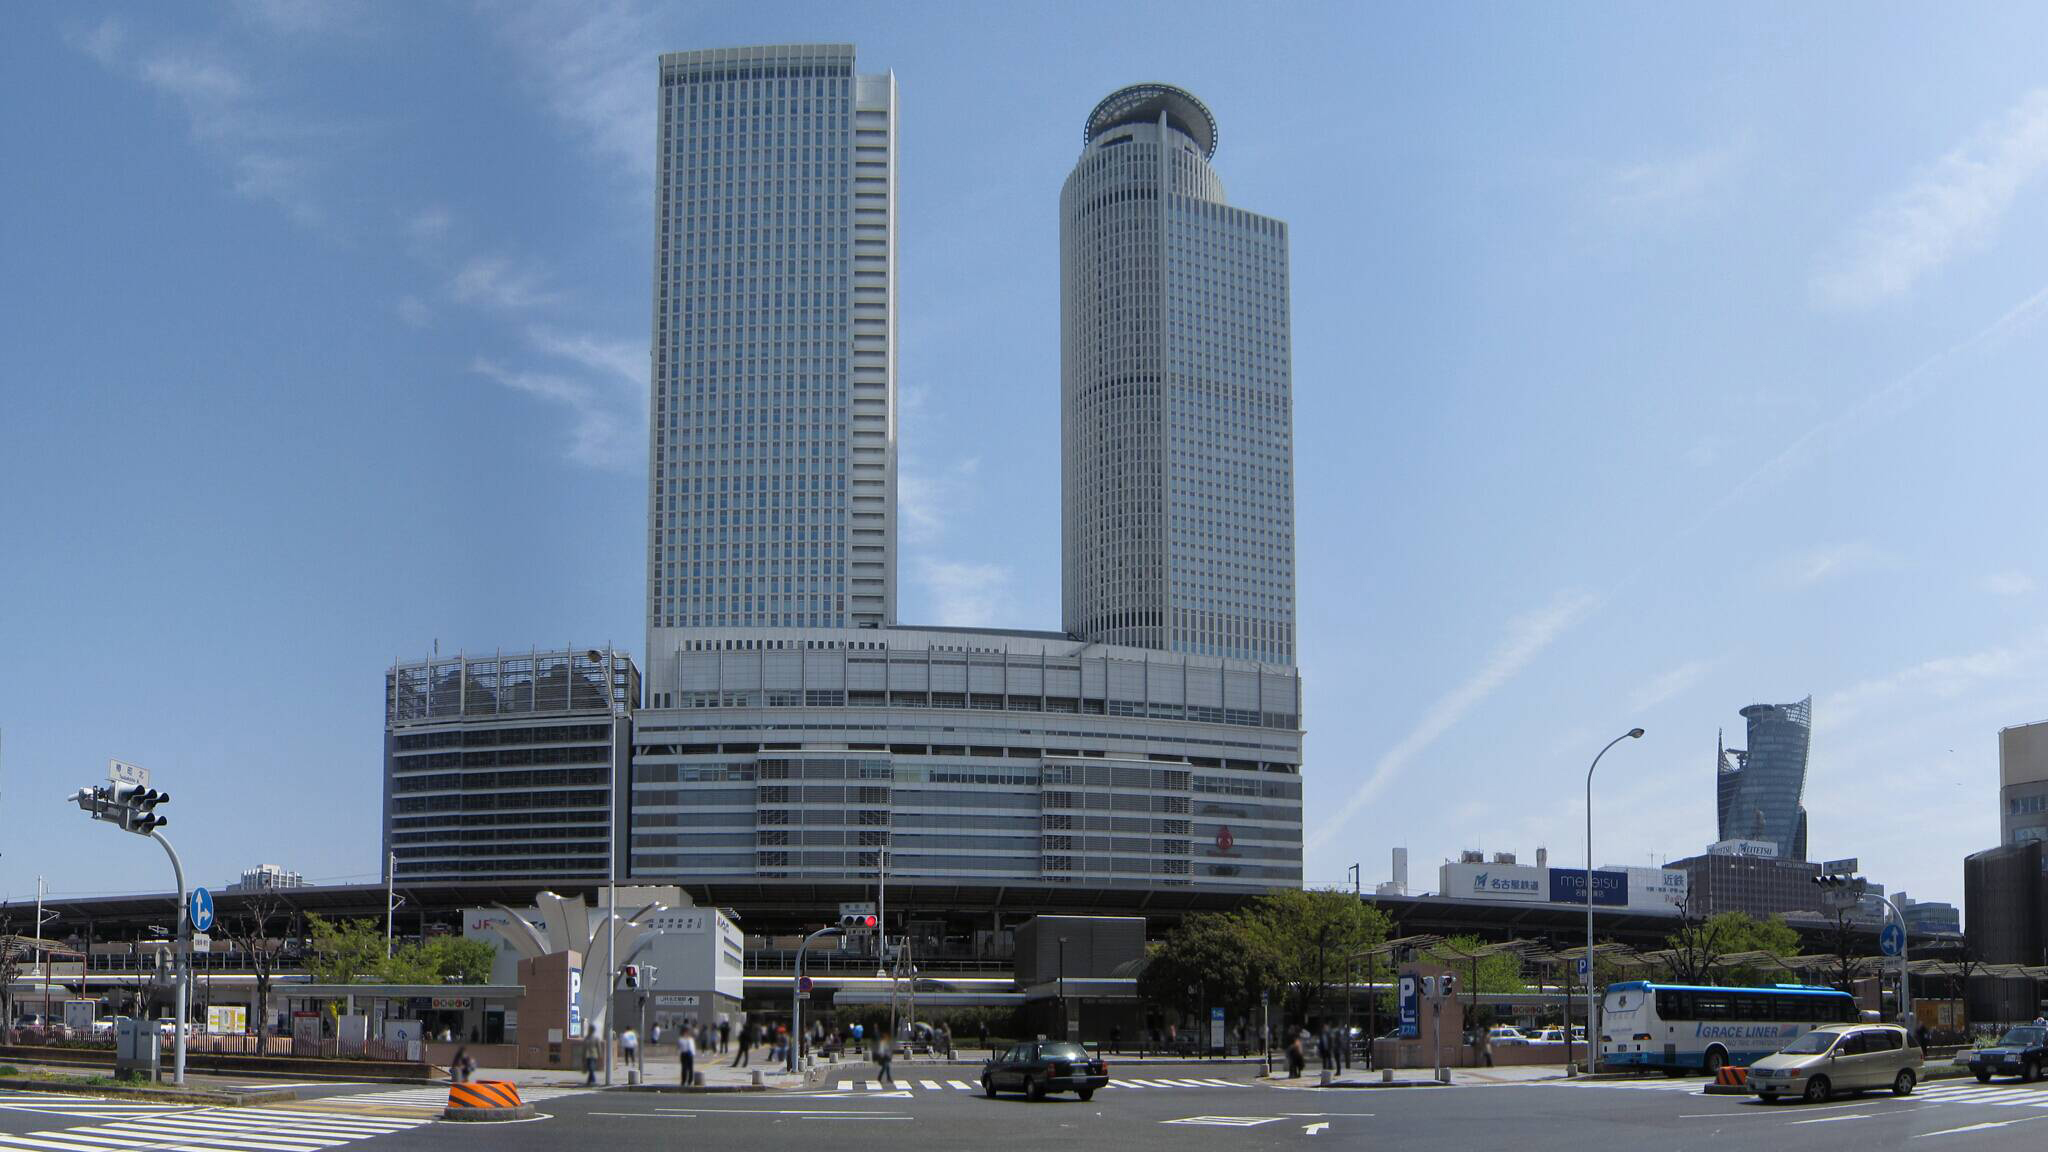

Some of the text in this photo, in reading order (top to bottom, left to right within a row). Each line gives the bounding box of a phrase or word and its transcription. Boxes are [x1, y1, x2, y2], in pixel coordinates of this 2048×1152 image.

[1492, 878, 1539, 891] 名古屋鉄道
[1664, 872, 1684, 887] 近鉄
[1580, 960, 1587, 975] P
[571, 971, 581, 1005] P
[1400, 977, 1415, 1007] P
[1702, 1026, 1778, 1038] GRACE LINER
